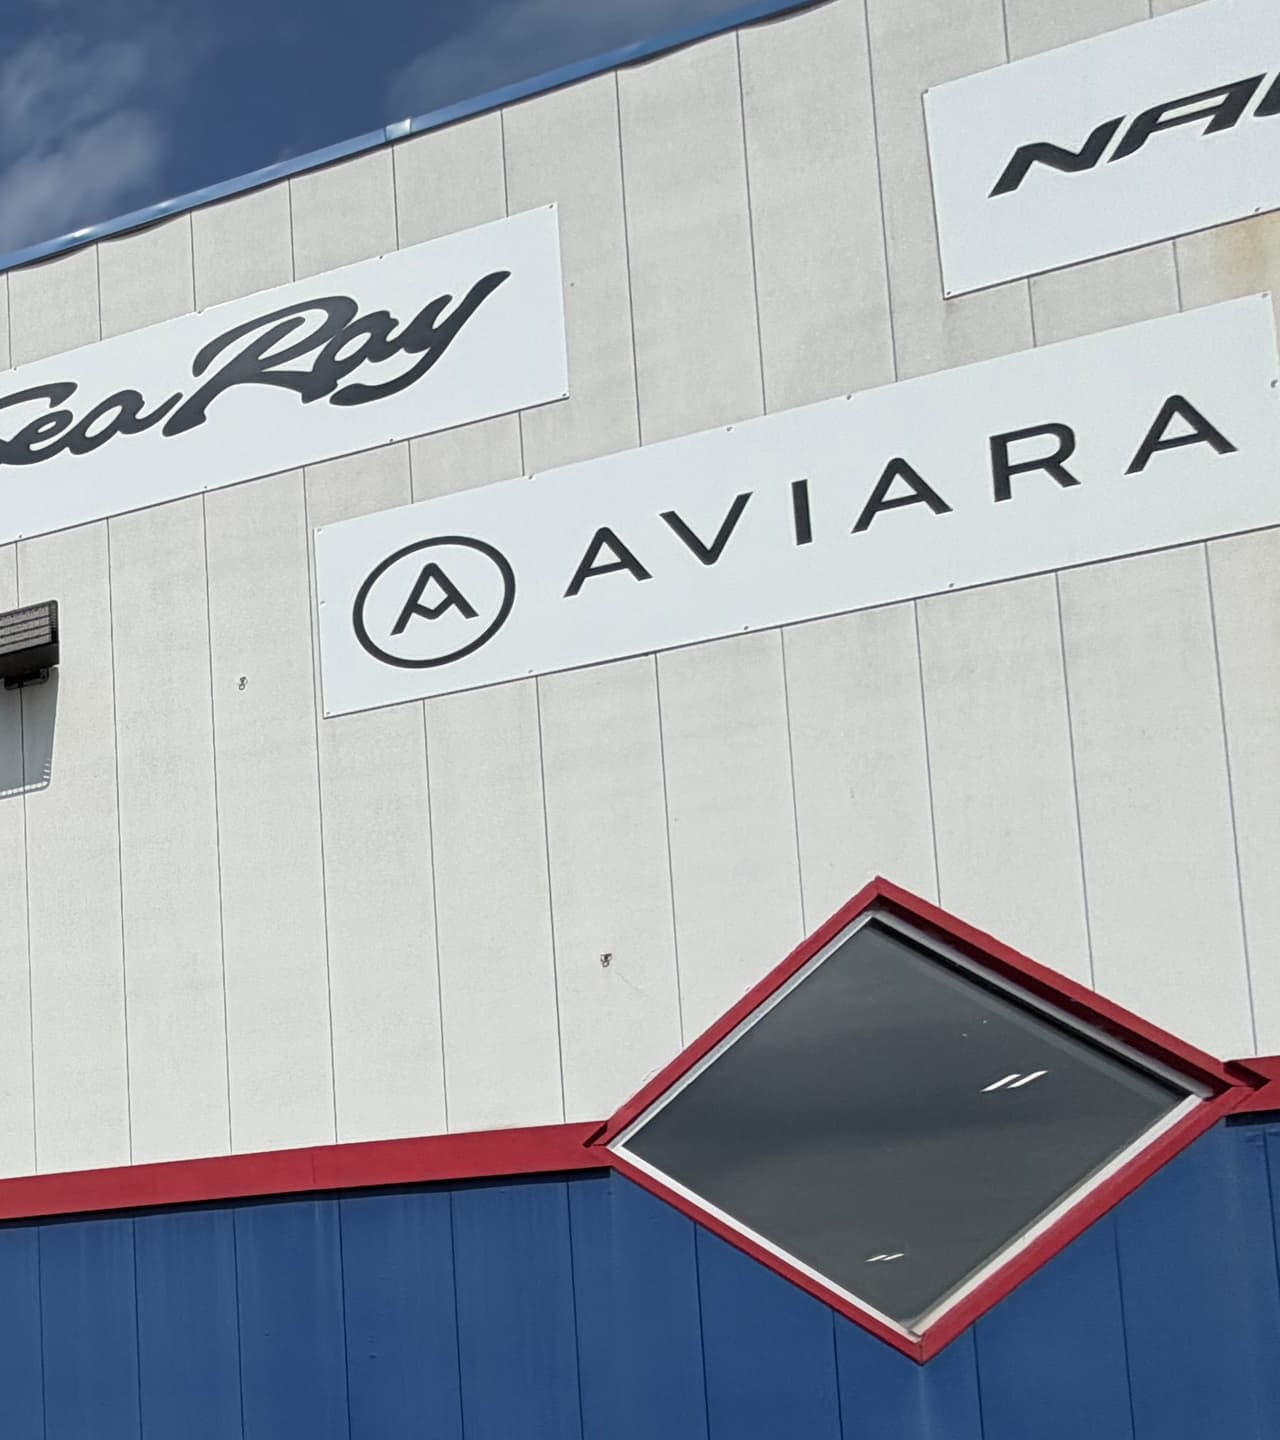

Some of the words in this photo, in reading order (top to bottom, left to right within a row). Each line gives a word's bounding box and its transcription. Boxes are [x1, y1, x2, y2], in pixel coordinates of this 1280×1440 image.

[988, 72, 1280, 199] NA
[162, 270, 511, 438] Ray
[563, 393, 1238, 598] AVIARA
